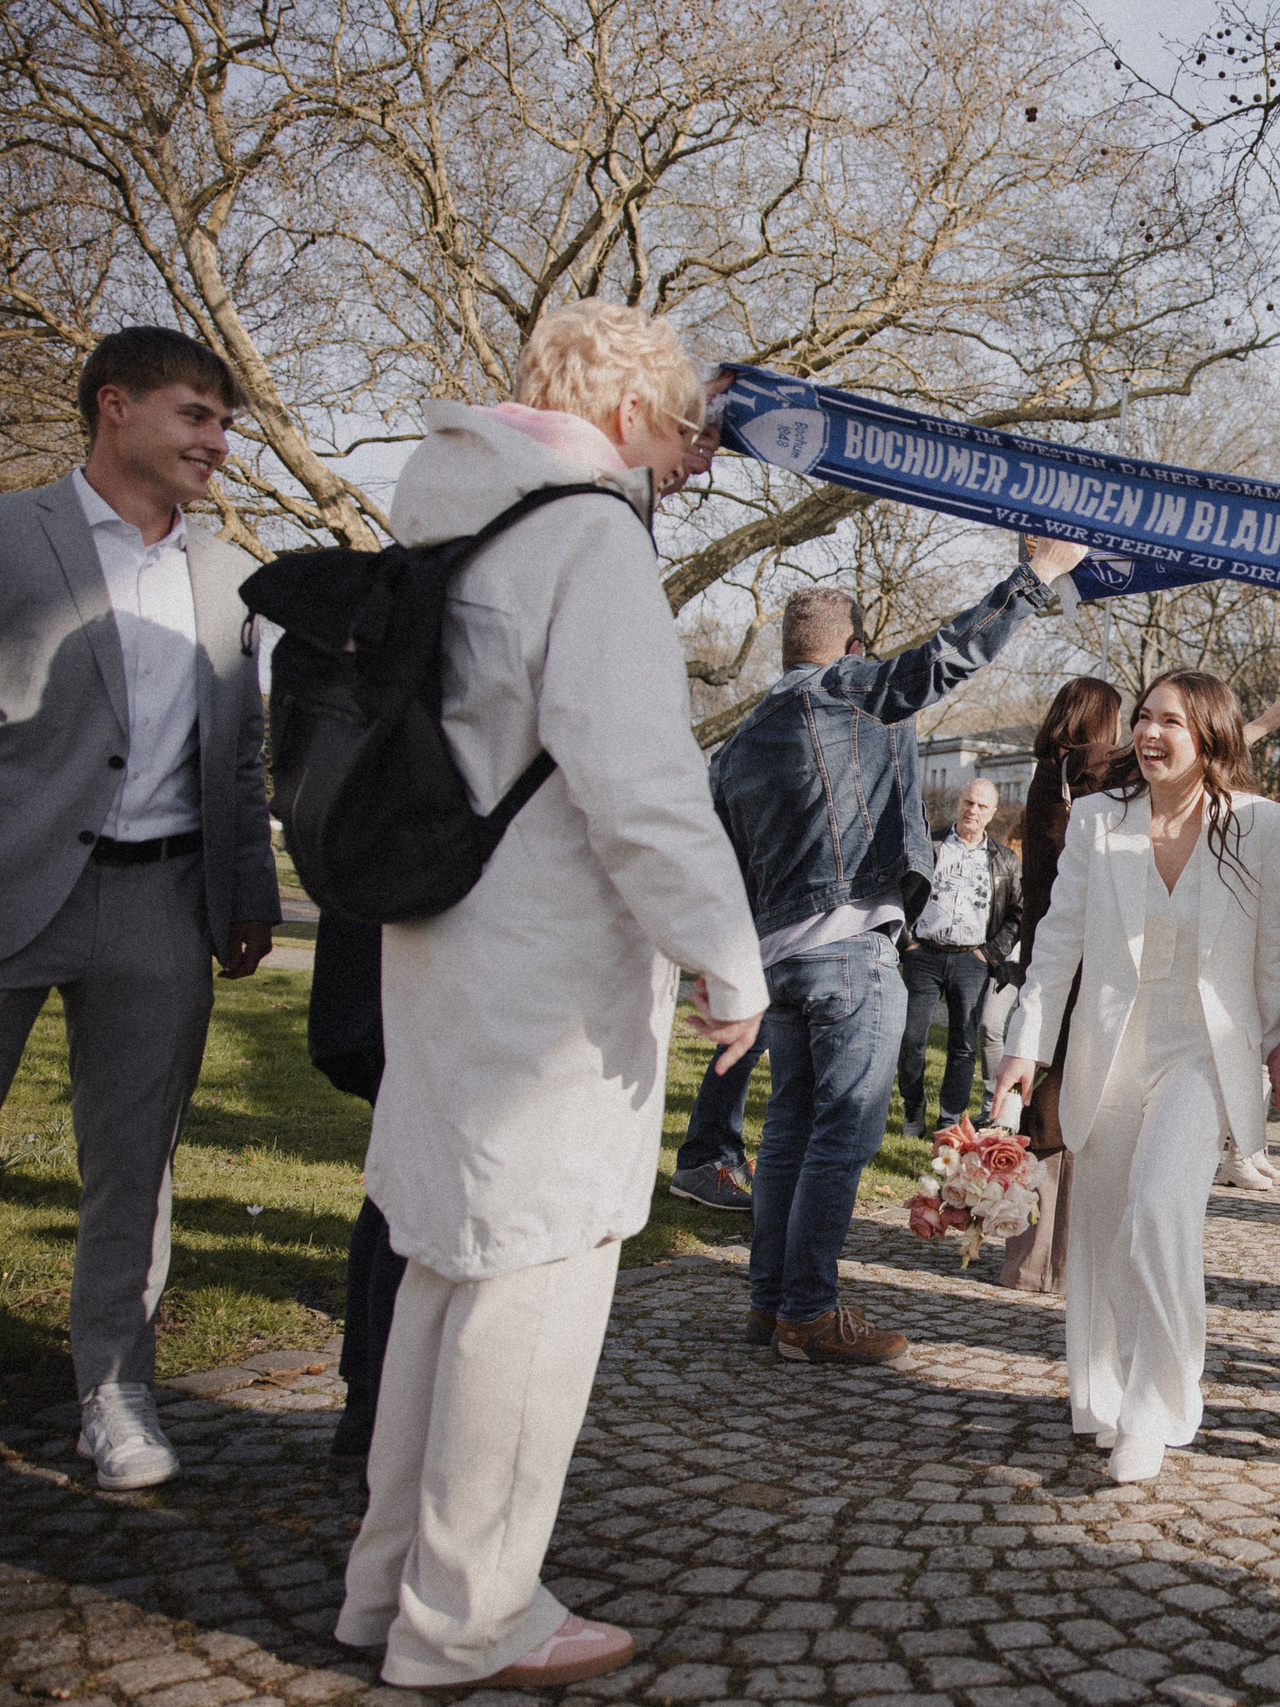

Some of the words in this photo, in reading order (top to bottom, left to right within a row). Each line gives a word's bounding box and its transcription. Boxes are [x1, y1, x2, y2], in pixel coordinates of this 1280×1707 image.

[776, 424, 791, 448] 1848
[790, 421, 808, 459] Bochum
[920, 418, 970, 438] TIEF
[974, 427, 1003, 447] IM
[1119, 462, 1203, 489] DAHER
[843, 418, 1009, 495] BOCHUMER
[1008, 461, 1144, 528] JUNGEN
[1143, 492, 1187, 537] IN
[1092, 532, 1185, 563] STEHEN
[1188, 553, 1225, 571] ZU
